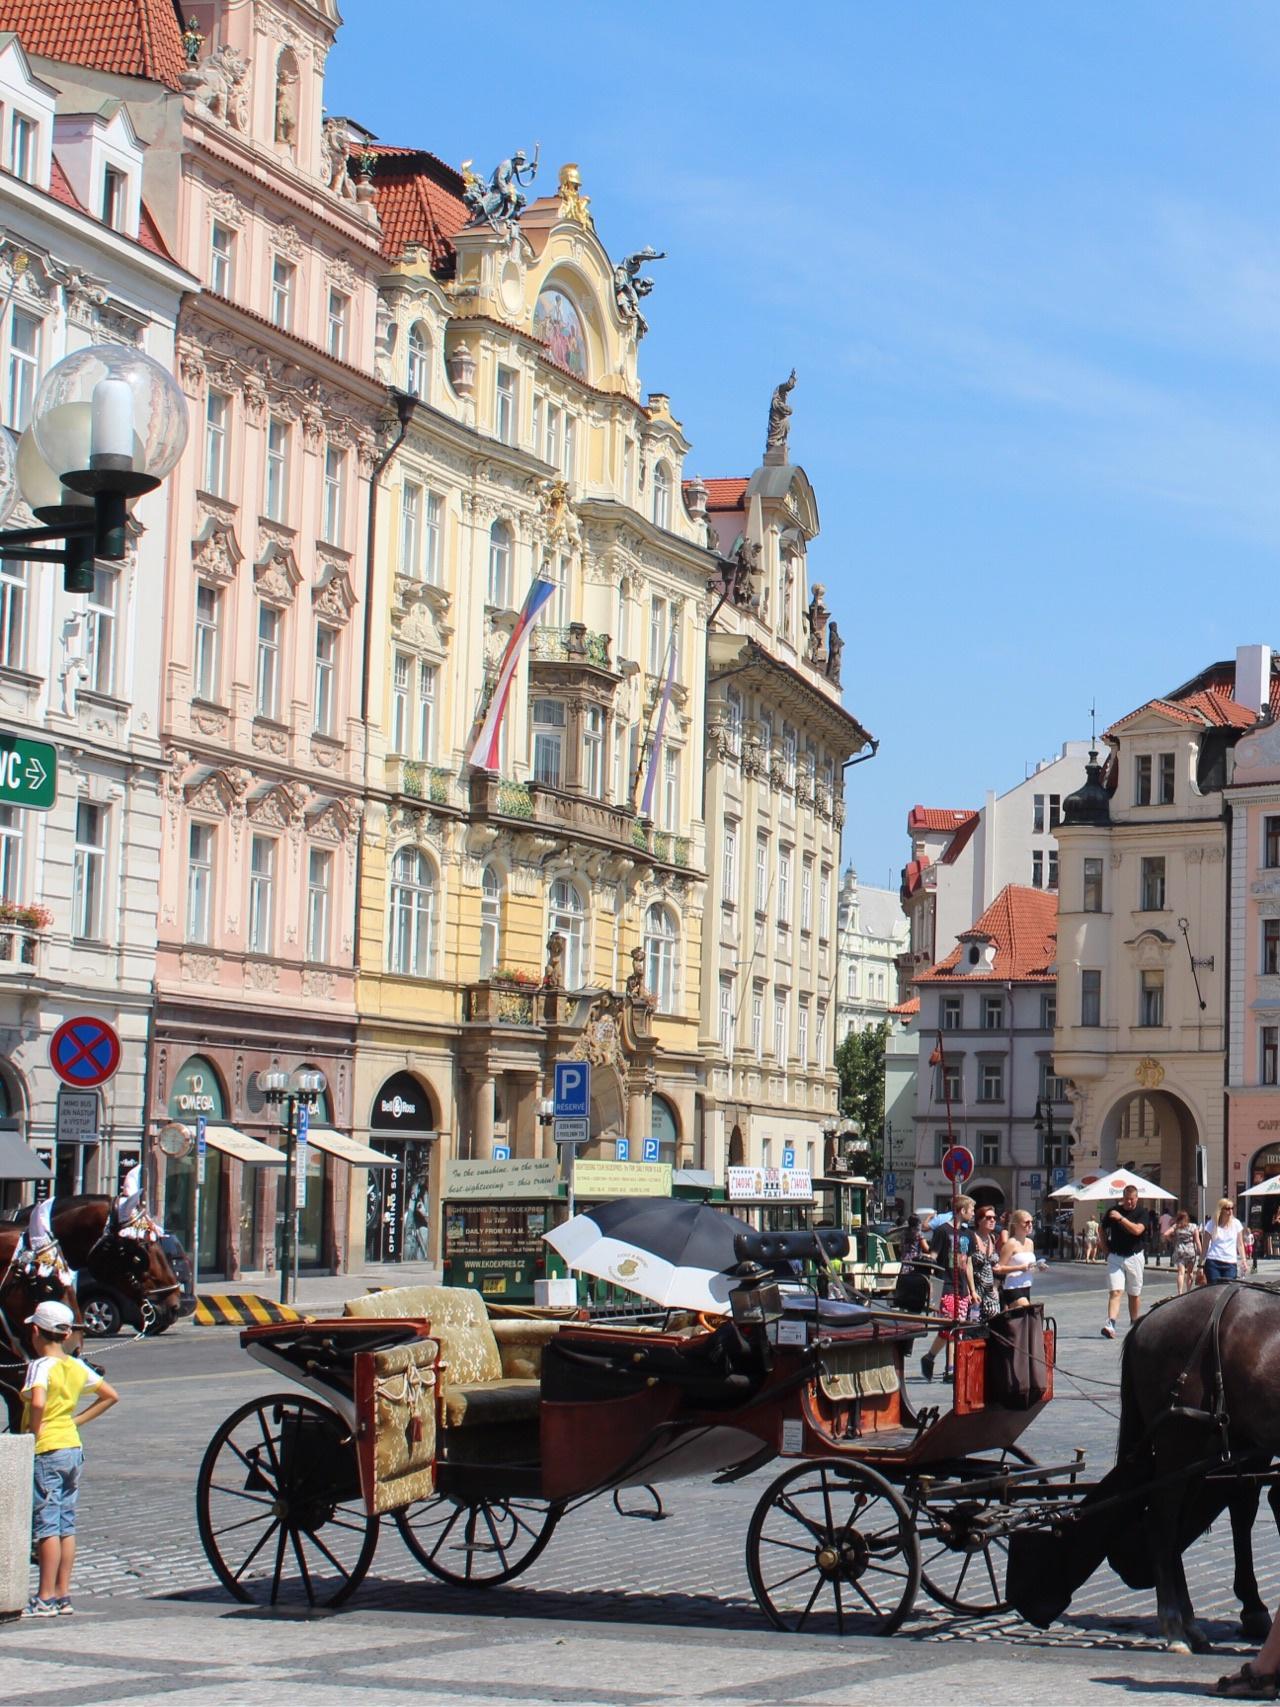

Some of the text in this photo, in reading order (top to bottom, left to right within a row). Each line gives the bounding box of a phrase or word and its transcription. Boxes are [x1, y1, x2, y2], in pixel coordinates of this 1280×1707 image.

[562, 1069, 581, 1100] P
[180, 1095, 215, 1111] OMEGA
[381, 1100, 393, 1112] Bell
[402, 1101, 416, 1113] Ross
[618, 1143, 625, 1160] P
[646, 1141, 655, 1158] P
[785, 1152, 792, 1167] P
[763, 1190, 781, 1198] TAXI
[388, 1193, 397, 1253] OPENING
[464, 1260, 526, 1268] WWW.EKOEXPRES.CZ
